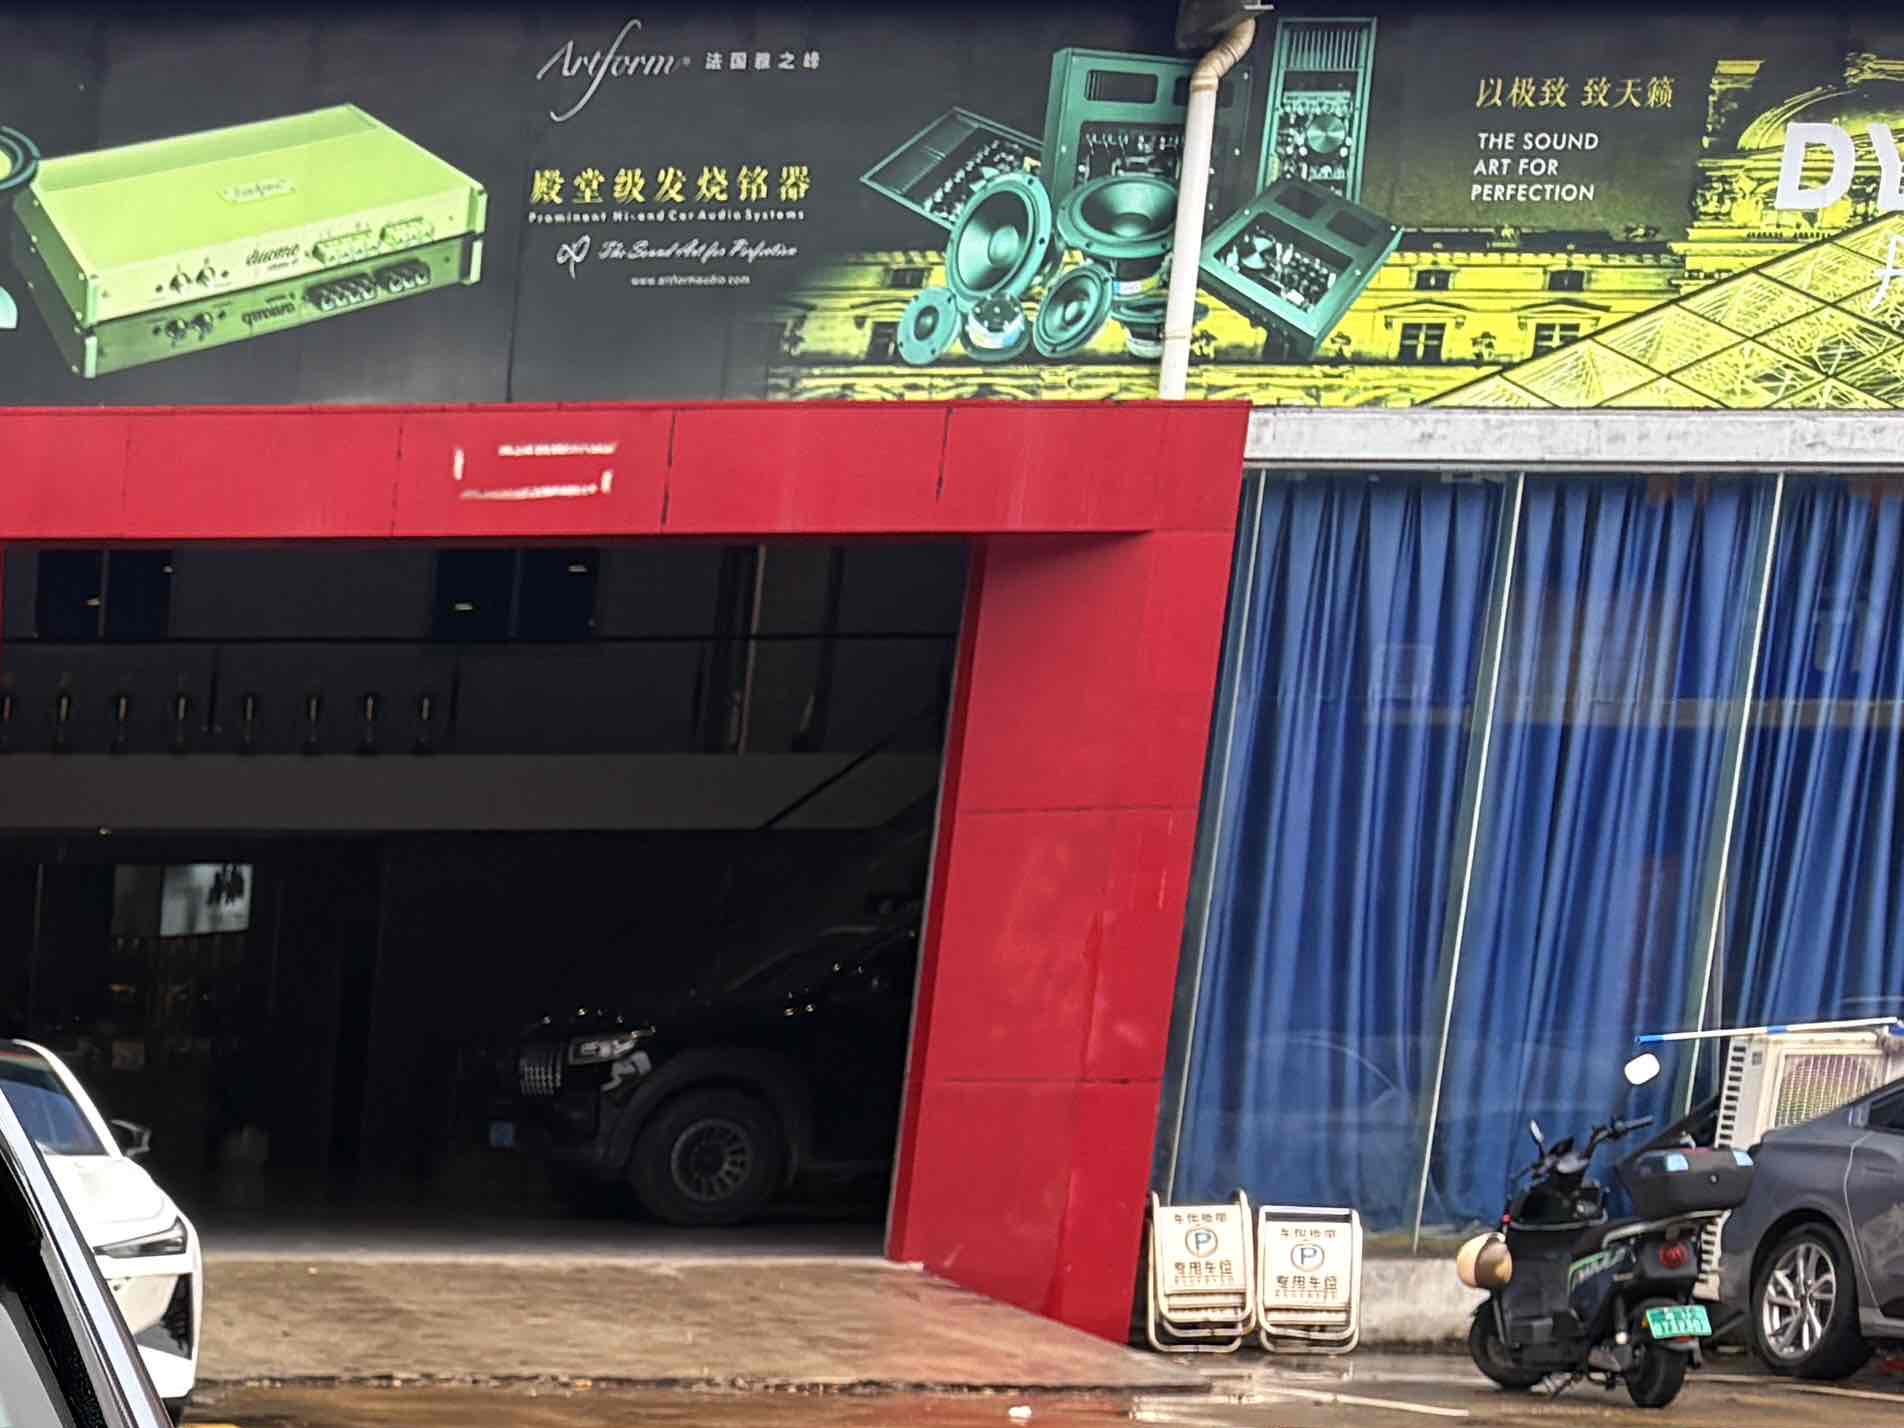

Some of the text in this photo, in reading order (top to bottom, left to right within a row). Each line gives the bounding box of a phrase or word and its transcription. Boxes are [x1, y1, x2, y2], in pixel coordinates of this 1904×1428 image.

[1475, 75, 1675, 109] 以极致 致天籁
[1478, 132, 1599, 150] THE SOUND
[1473, 158, 1559, 175] ART FOR
[529, 165, 812, 204] 殿堂级发烧铭器
[1471, 183, 1595, 201] PERFECTION
